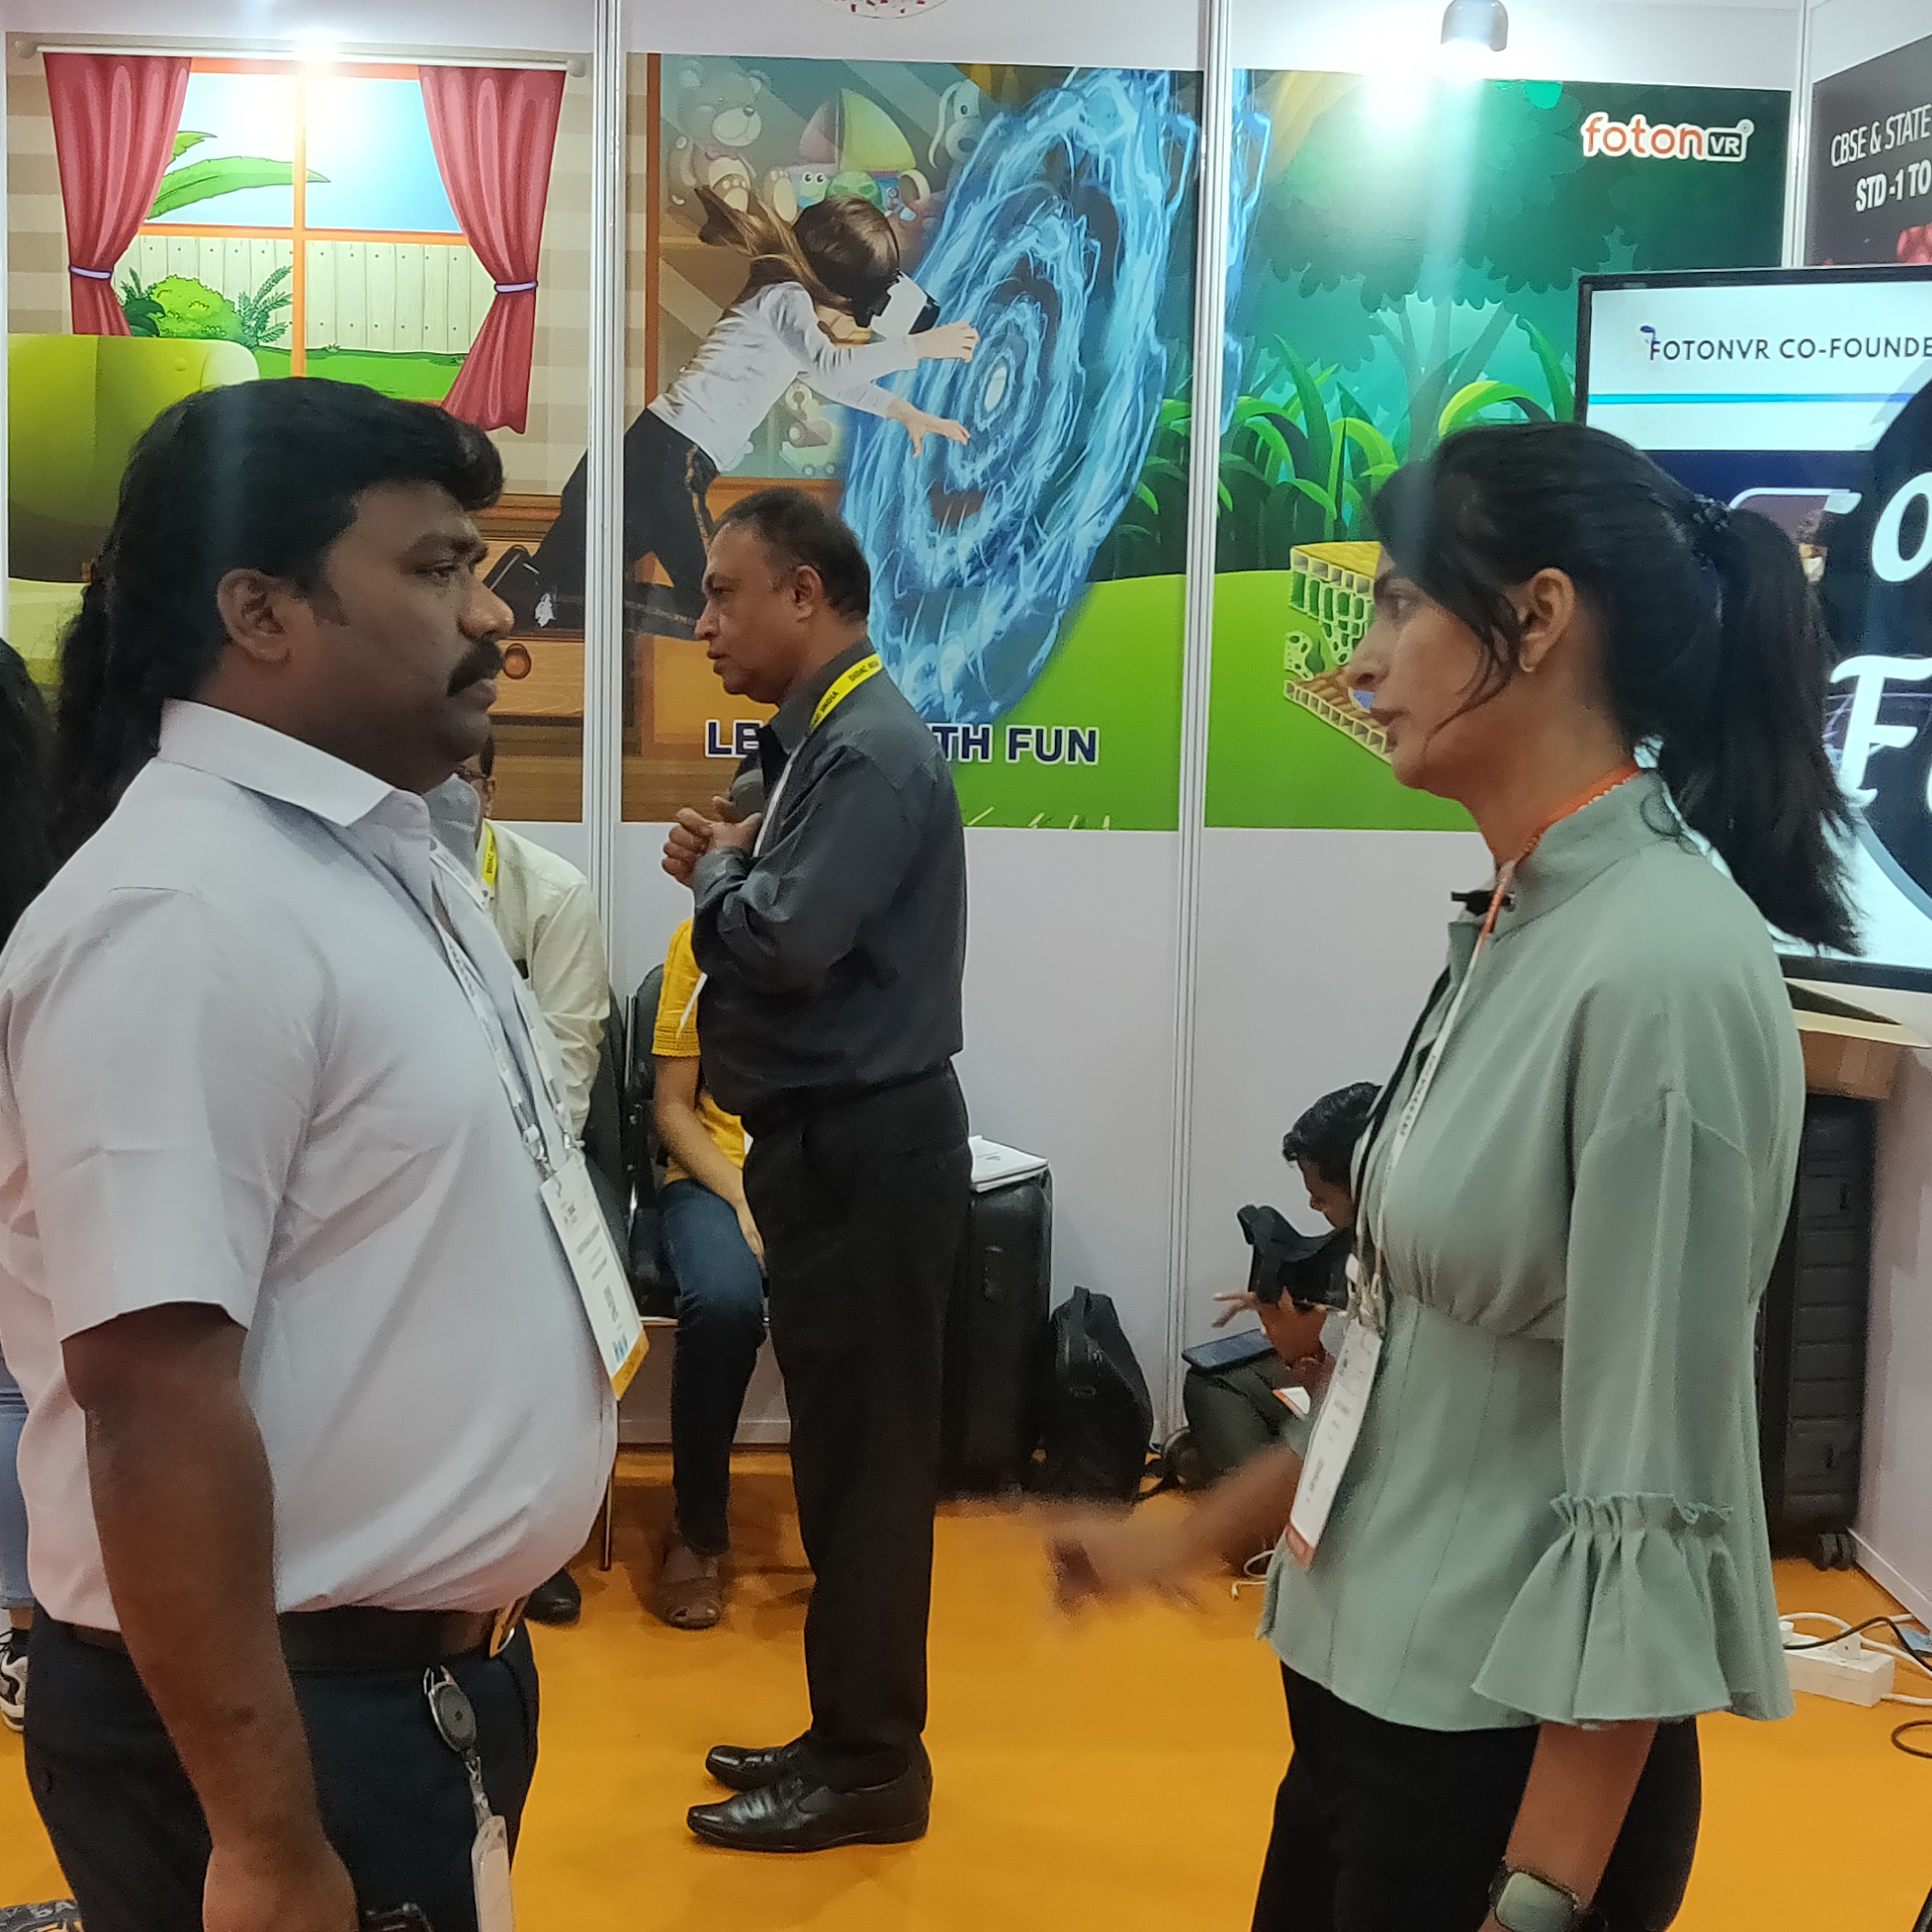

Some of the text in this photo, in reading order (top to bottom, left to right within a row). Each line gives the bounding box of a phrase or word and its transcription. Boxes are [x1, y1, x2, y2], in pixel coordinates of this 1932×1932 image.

[1831, 103, 1932, 166] CBSE & STATE
[1855, 174, 1887, 212] STD
[1908, 159, 1932, 197] TO
[1649, 338, 1772, 361] FOTONVR
[1007, 725, 1099, 765] FUN
[1830, 654, 1932, 807] F
